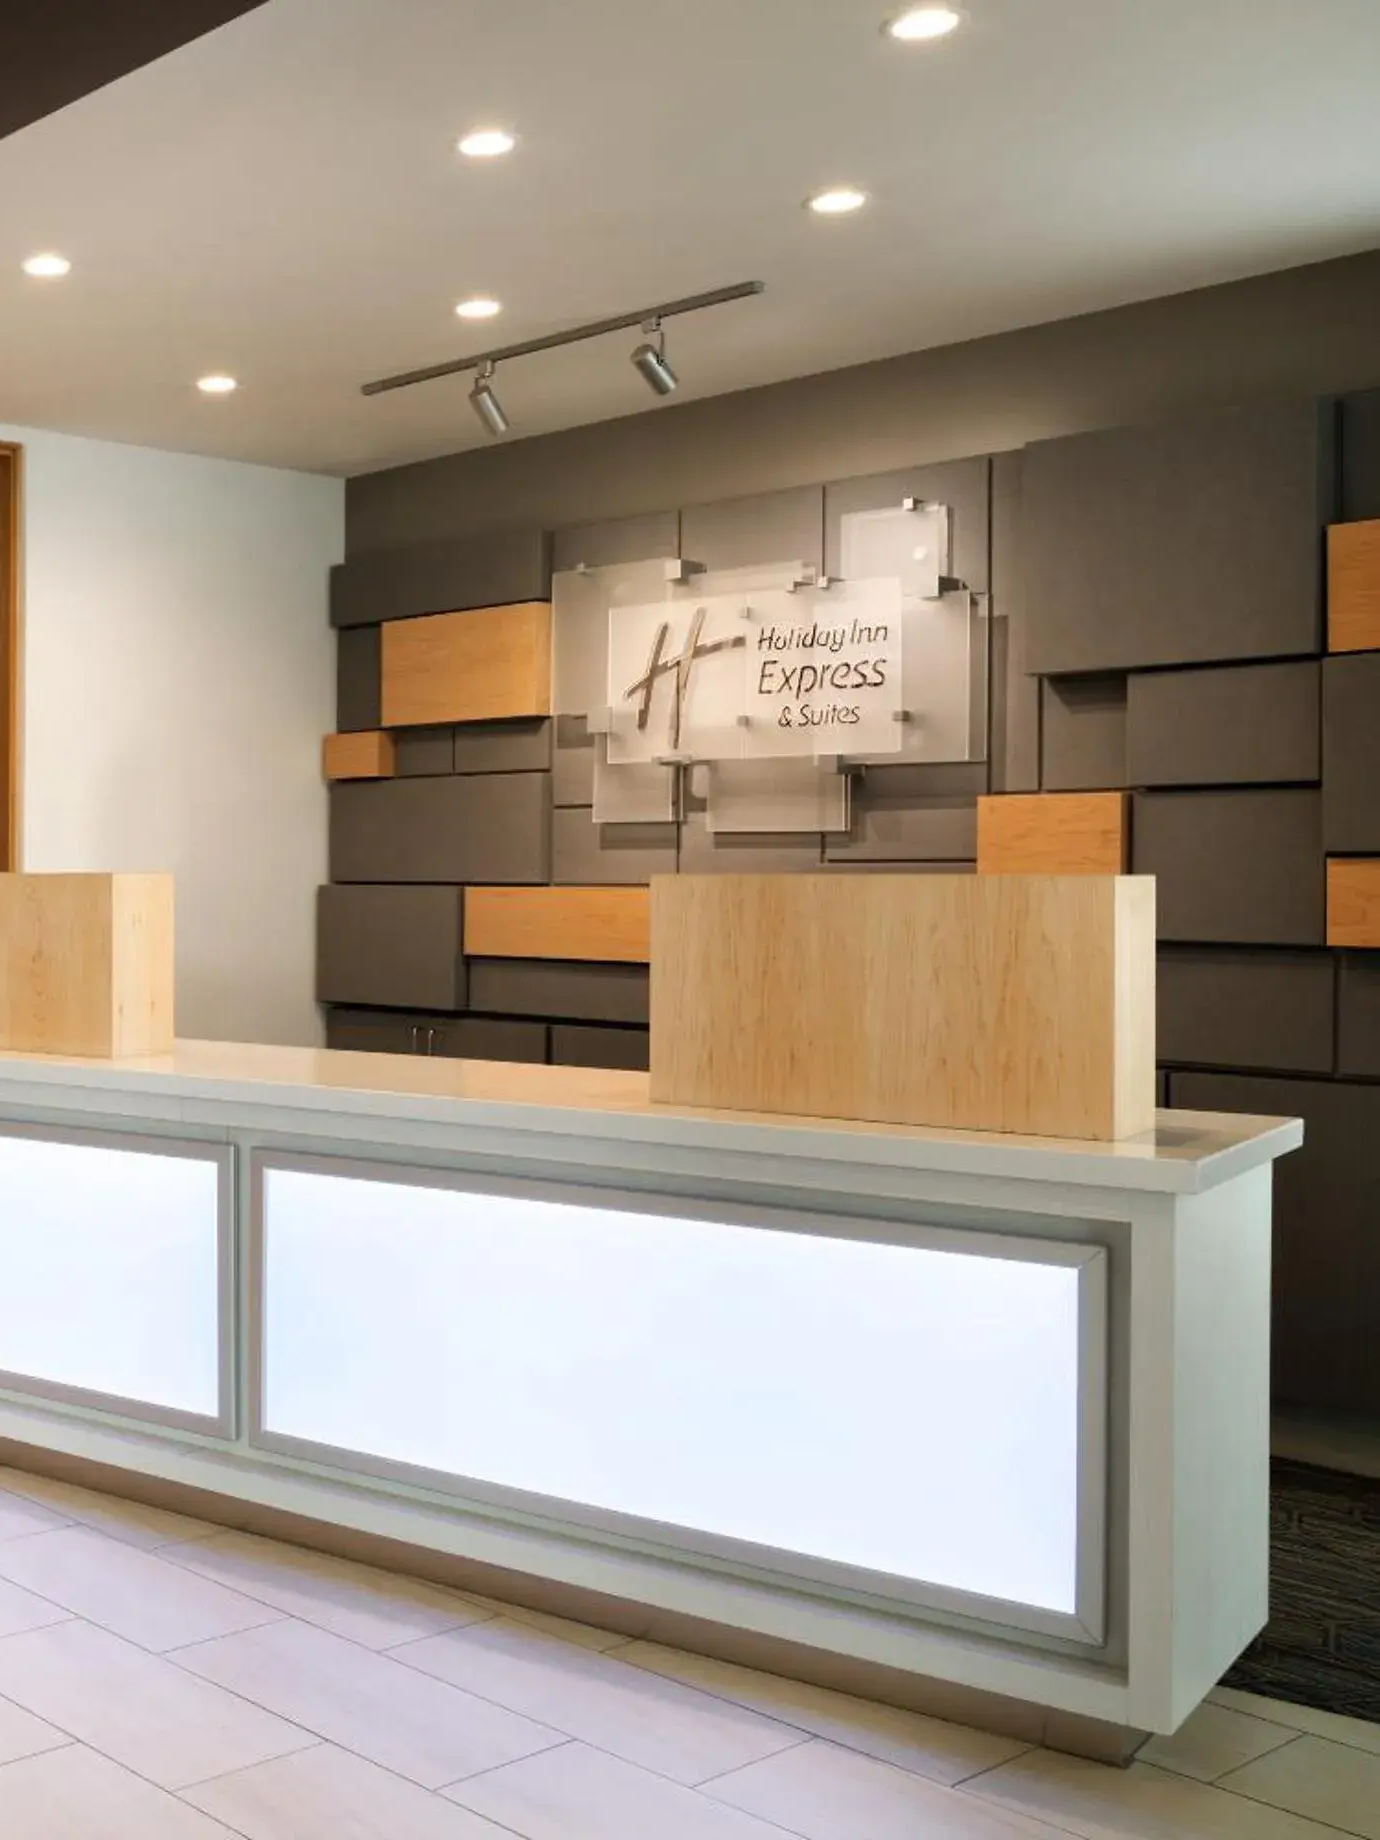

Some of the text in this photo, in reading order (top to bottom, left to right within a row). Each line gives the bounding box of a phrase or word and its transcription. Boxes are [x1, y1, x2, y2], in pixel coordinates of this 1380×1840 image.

[758, 618, 888, 652] Holiday Inn
[758, 658, 888, 700] Express
[778, 704, 861, 728] & Suites
